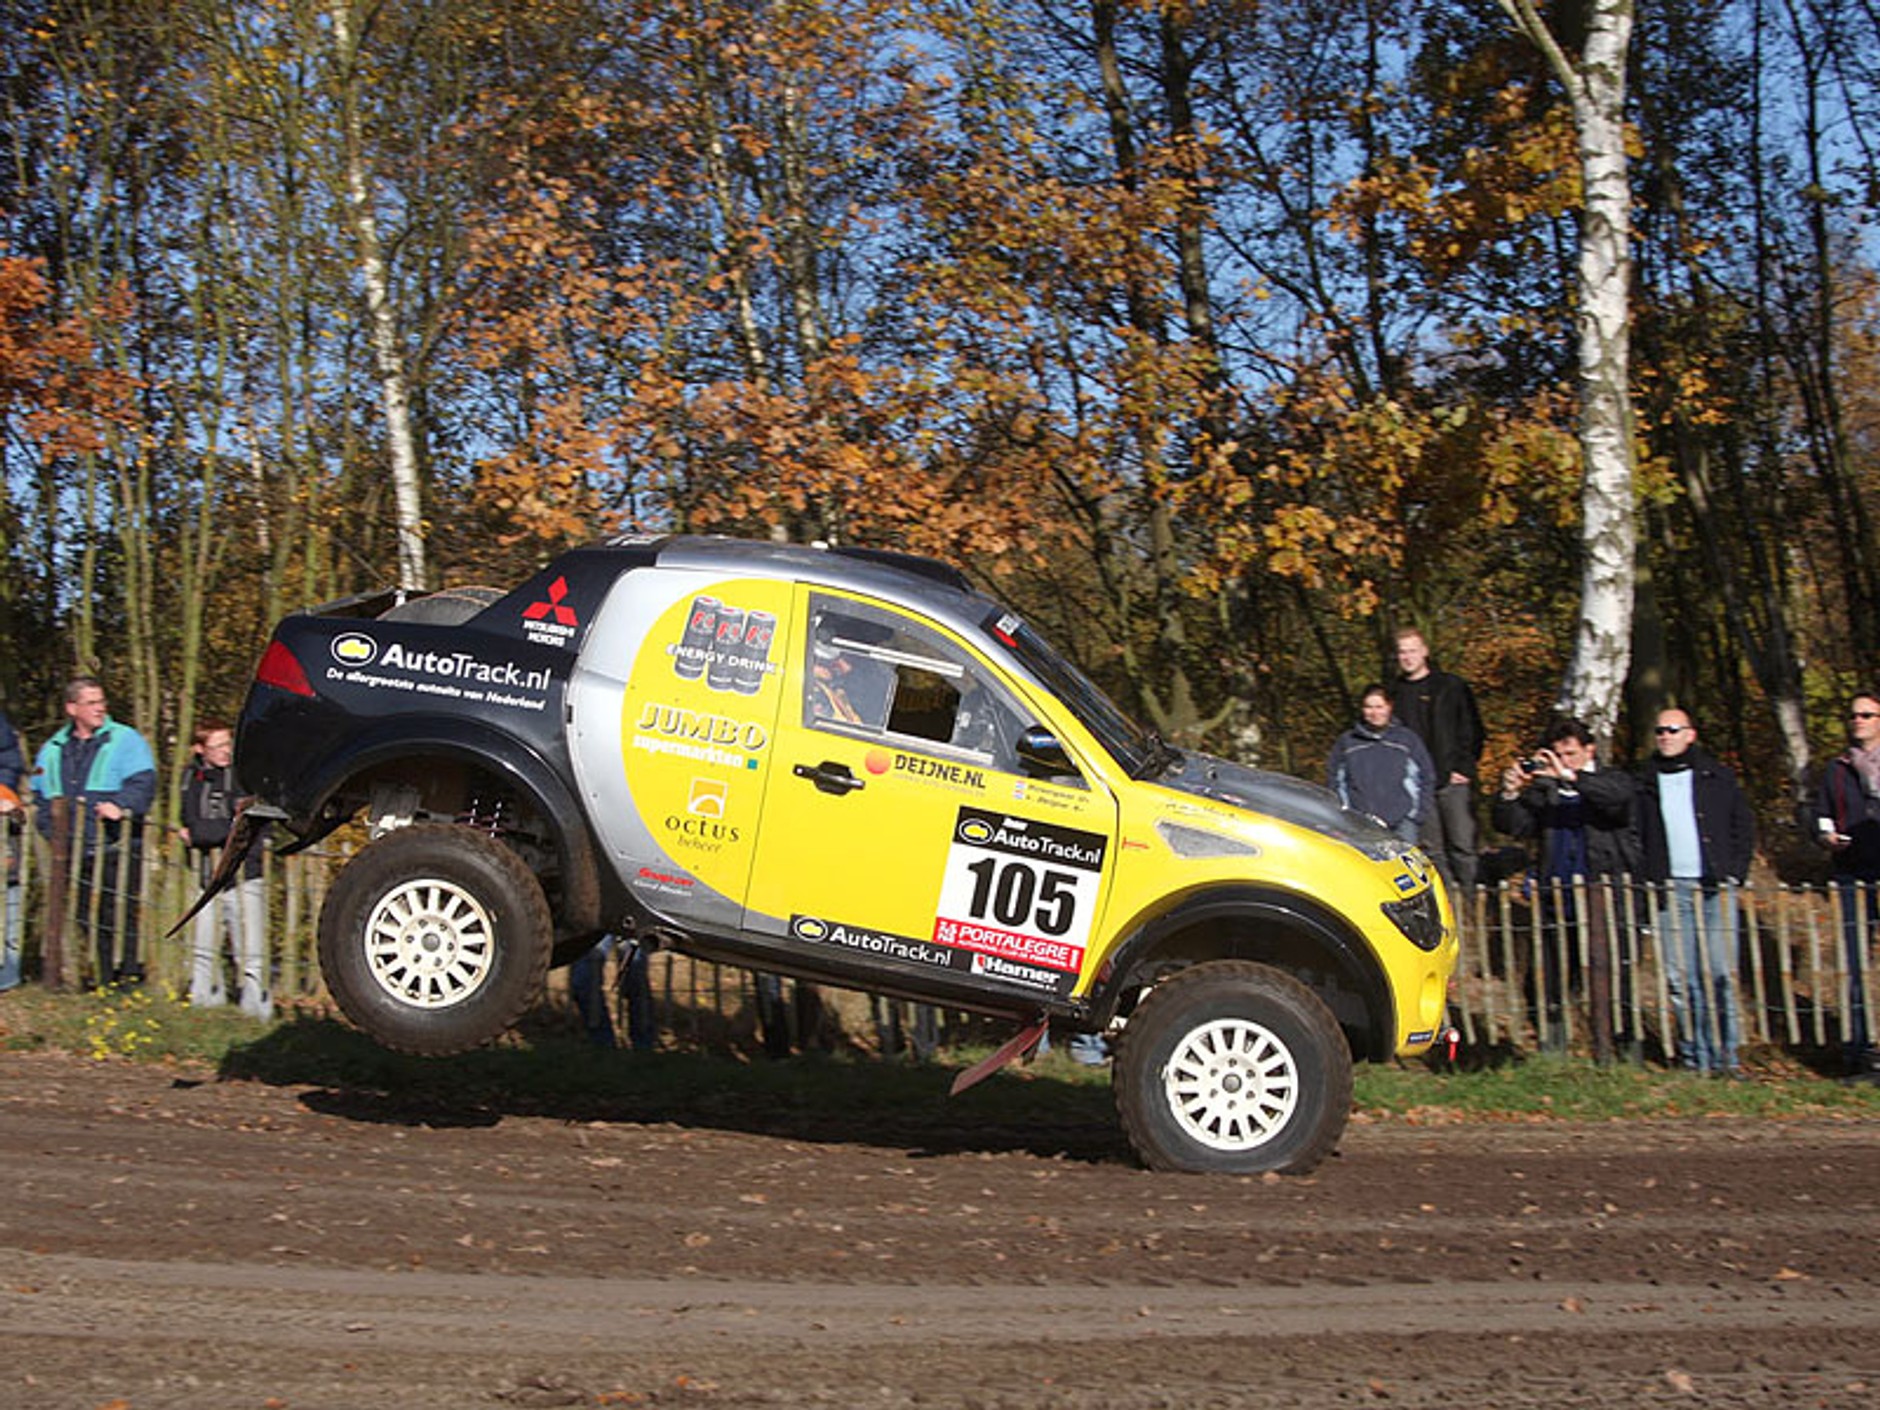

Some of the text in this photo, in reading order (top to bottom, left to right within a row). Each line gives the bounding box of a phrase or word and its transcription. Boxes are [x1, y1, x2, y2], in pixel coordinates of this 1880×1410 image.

[380, 643, 551, 690] AutoTrack.nl
[666, 643, 725, 664] ENERGY
[326, 667, 343, 680] De
[463, 690, 483, 701] van
[485, 691, 546, 710] Nederland
[637, 702, 767, 751] JUMBO
[633, 735, 742, 768] supermarkten
[894, 754, 986, 789] DEIJNE.NL
[994, 829, 1101, 864] AutoTrack.nl
[967, 857, 1079, 936] 105
[829, 926, 952, 966] AutoTrack.nl
[959, 926, 1070, 960] PORTALEGRE
[987, 956, 1061, 984] Hamer
